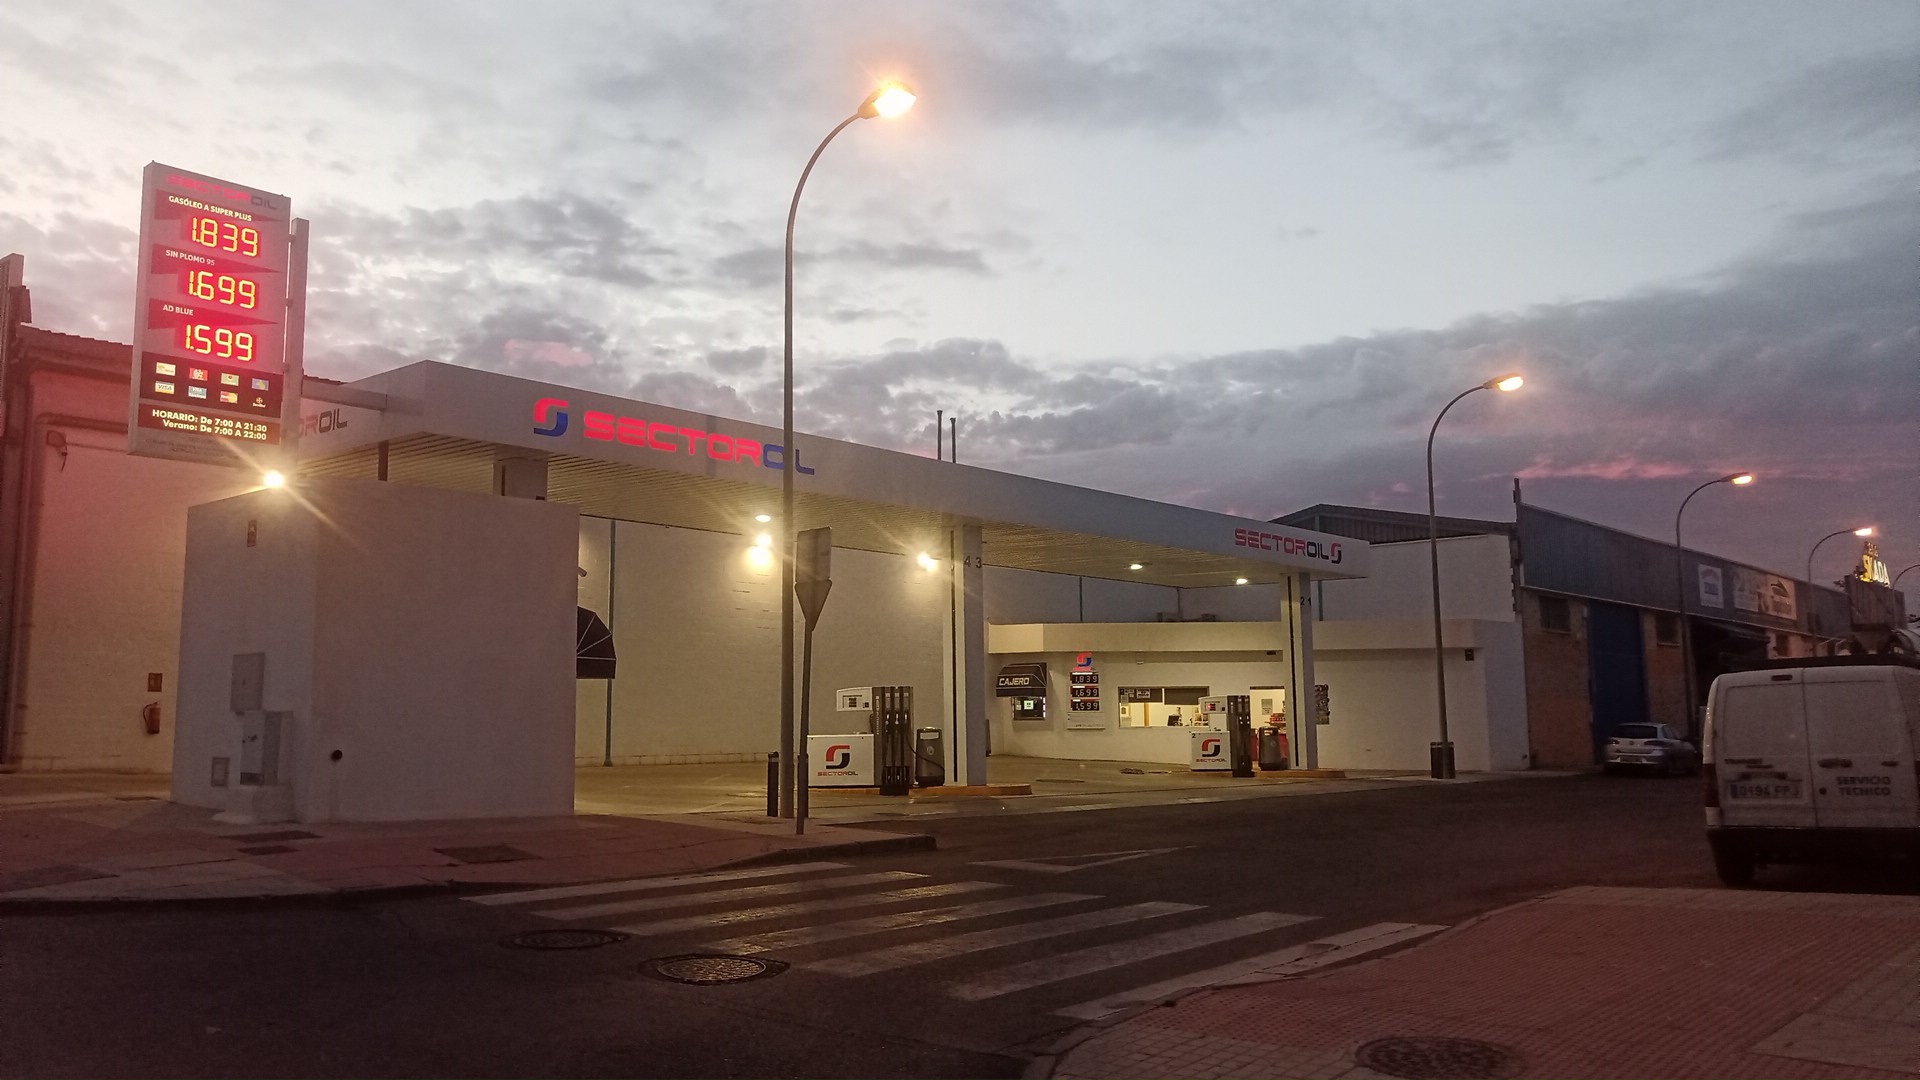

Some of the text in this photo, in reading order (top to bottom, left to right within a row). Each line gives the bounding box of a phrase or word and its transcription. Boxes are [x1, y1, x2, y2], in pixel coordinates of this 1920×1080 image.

[168, 195, 203, 210] GASÓLEO
[210, 205, 234, 217] SUPER
[234, 211, 252, 222] PLUS
[191, 217, 258, 257] 1.839
[165, 249, 215, 266] SIN PLOMO 95
[188, 270, 256, 309] 1.699
[162, 304, 194, 316] AD BLUE
[185, 324, 253, 361] 1.599
[152, 409, 199, 423] HORARIO:
[200, 416, 213, 425] De
[214, 418, 234, 428] 7:00
[243, 422, 267, 433] 21:30
[162, 419, 198, 431] Verano:
[200, 424, 212, 433] De
[214, 426, 233, 436] 7:00
[243, 431, 267, 440] 22:00
[583, 410, 815, 475] SECTOROL
[1234, 528, 1329, 561] SECTOROIL
[975, 557, 982, 569] 3
[998, 677, 1030, 686] CAJERO
[1836, 776, 1892, 785] SERVICIO
[1839, 787, 1892, 796] TECNICO
